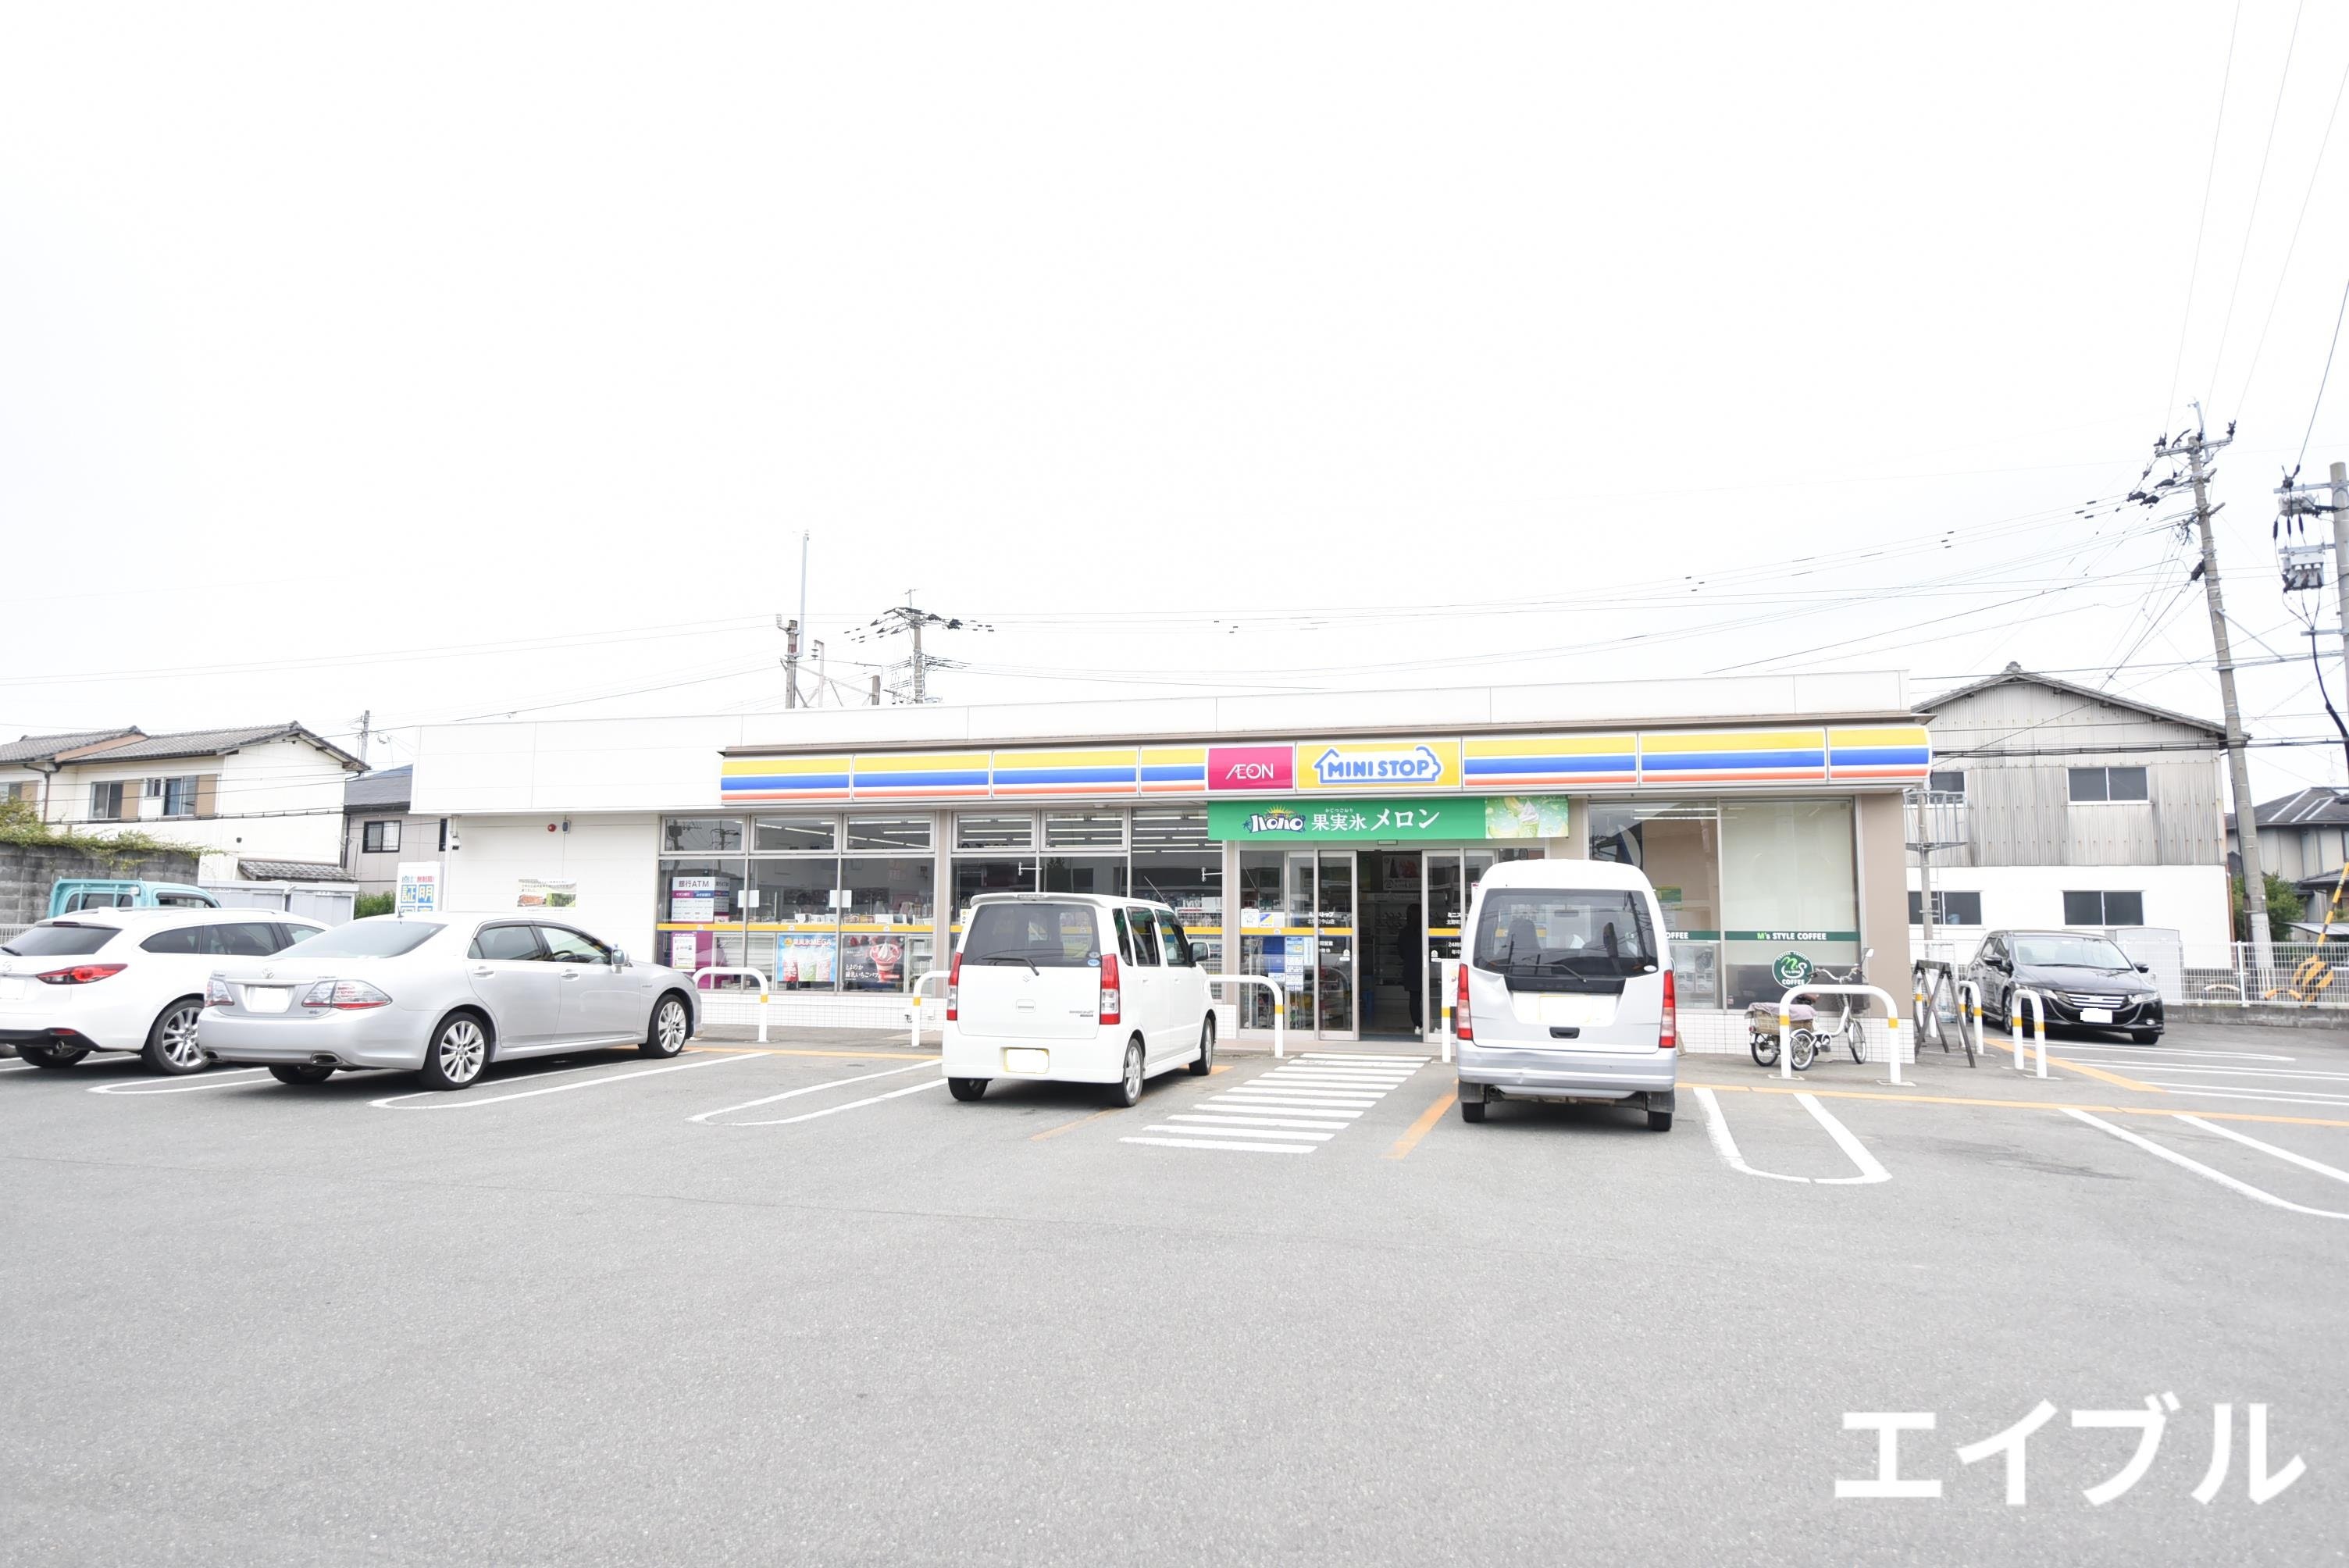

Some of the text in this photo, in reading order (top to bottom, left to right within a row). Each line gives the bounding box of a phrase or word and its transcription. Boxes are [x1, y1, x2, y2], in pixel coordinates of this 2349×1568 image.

[1311, 808, 1440, 832] 果実氷 メロン
[401, 884, 434, 903] 証明
